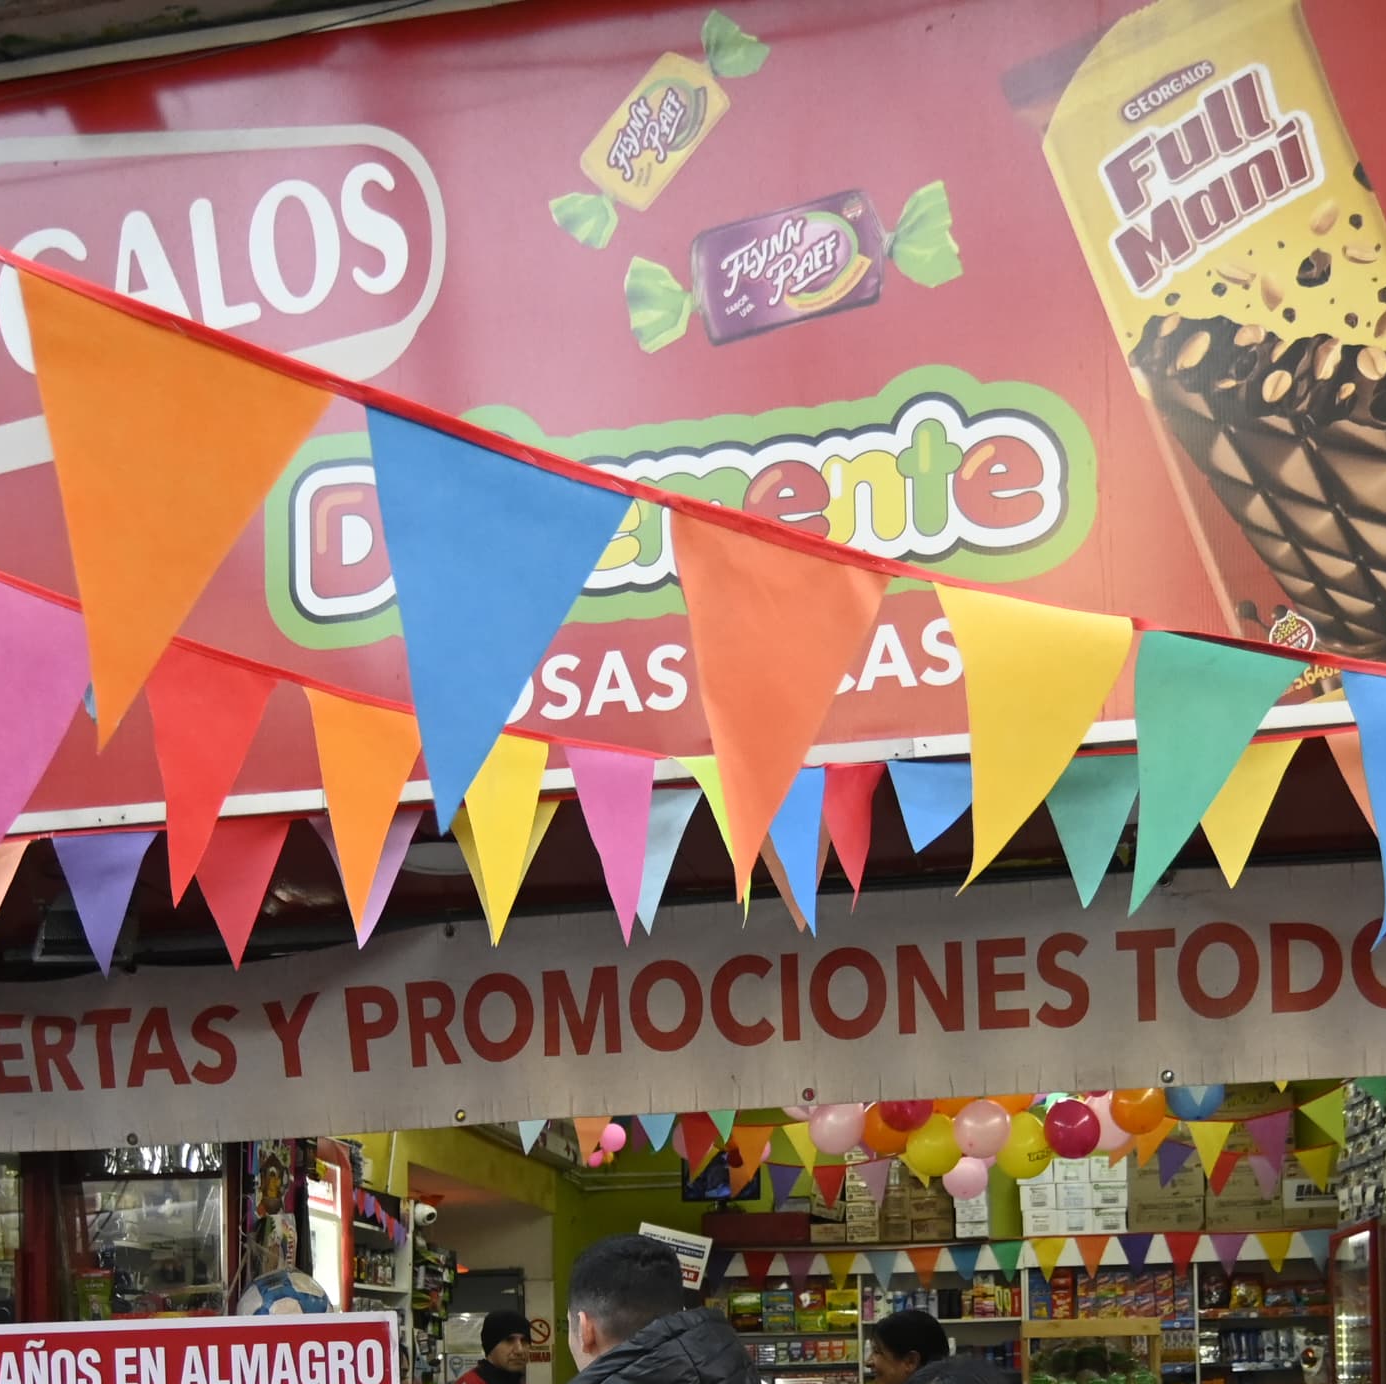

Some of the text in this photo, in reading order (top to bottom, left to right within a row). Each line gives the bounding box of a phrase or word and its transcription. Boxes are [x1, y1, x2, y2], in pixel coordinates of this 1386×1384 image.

[643, 88, 684, 162] PAFF
[1124, 62, 1214, 121] GEORGALOS
[607, 97, 651, 181] FLYNN
[1103, 70, 1272, 219] Full
[1114, 117, 1313, 291] Maní
[721, 218, 806, 298] FLYNN
[766, 231, 838, 306] PAFF
[269, 992, 318, 1077] Y
[346, 931, 1090, 1072] PROMOCIONES
